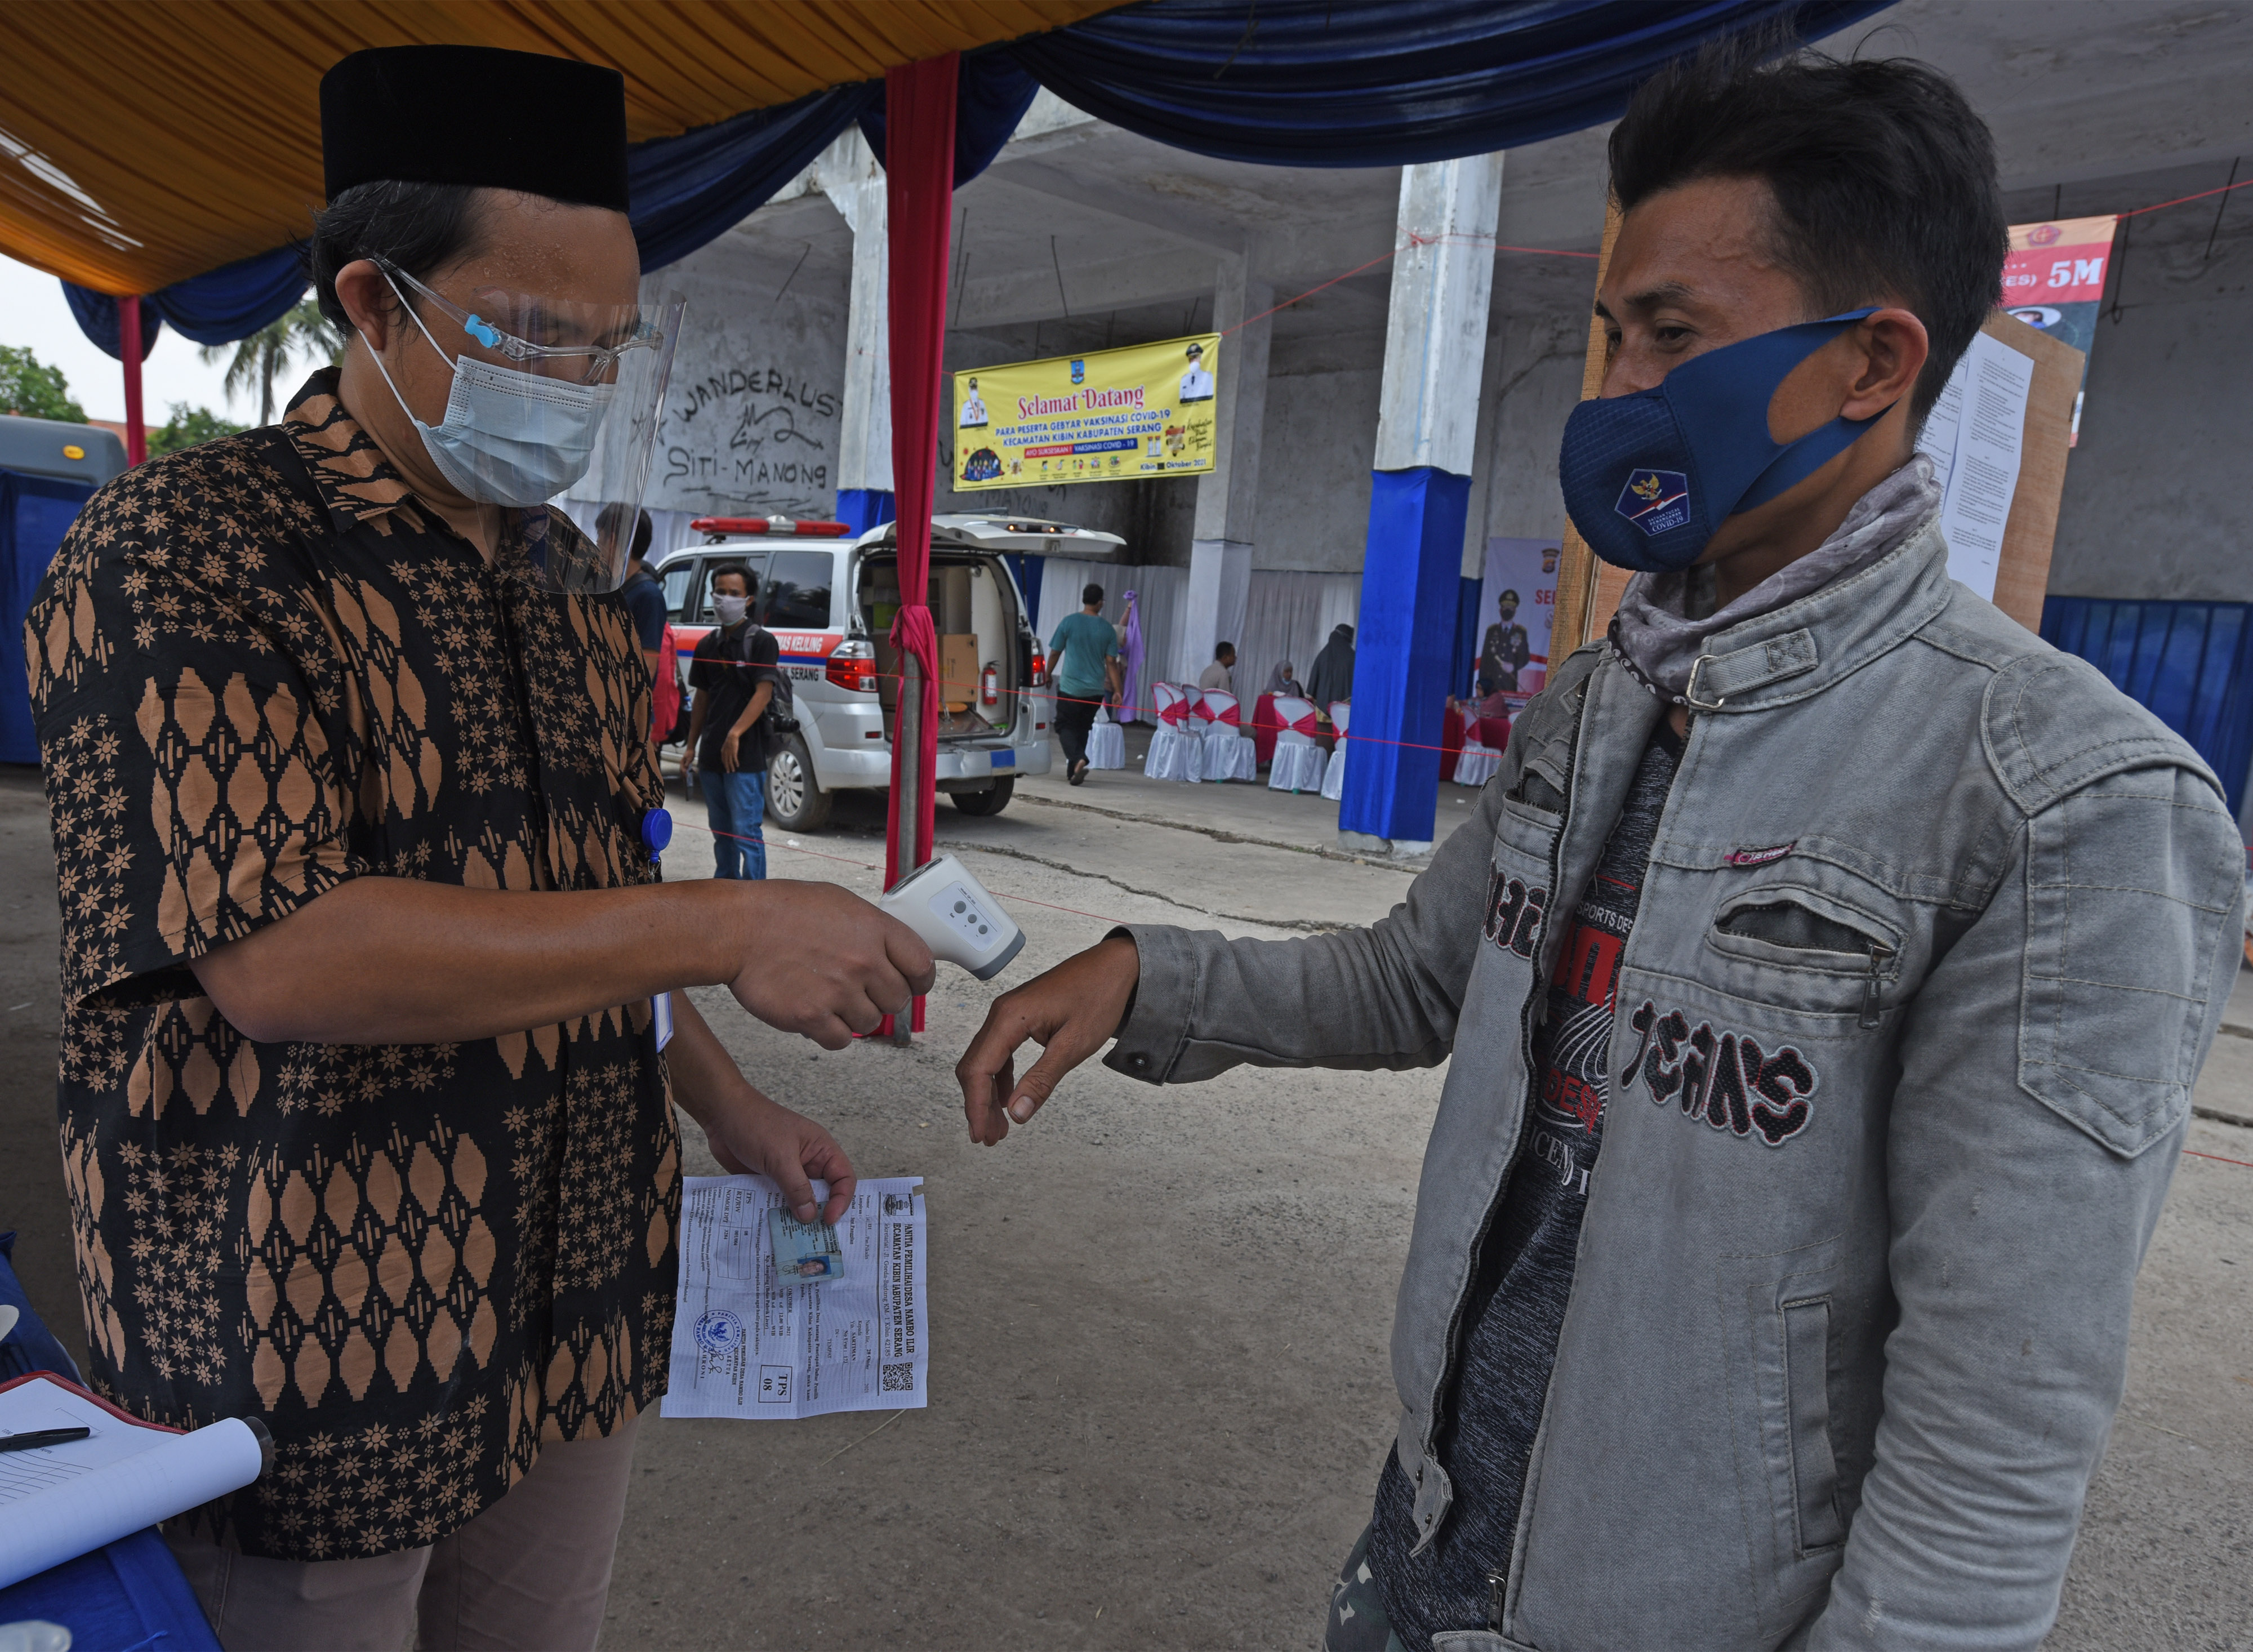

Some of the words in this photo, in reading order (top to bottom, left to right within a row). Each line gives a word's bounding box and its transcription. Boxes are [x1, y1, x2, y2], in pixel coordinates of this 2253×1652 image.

[2047, 257, 2104, 288] 5M
[1018, 394, 1078, 420] Selamat
[1081, 385, 1145, 410] Datang
[996, 427, 1016, 436] PARA
[1018, 423, 1048, 434] PESERTA
[1050, 420, 1081, 431] GEBYAR
[1083, 413, 1128, 426] VAKSINASI
[1130, 409, 1171, 422] COVID-19
[1003, 434, 1050, 447] KECAMATAN
[1052, 431, 1074, 442] KIBIN
[1076, 426, 1124, 439] KABUPATEN
[1126, 422, 1162, 434] SERANG
[1652, 516, 1683, 532] COVID-19
[790, 667, 818, 681] SERANG
[1577, 902, 1617, 927] SPORTS
[905, 1287, 913, 1307] DESA
[718, 1312, 737, 1325] PANITIA
[905, 1309, 914, 1336] NAMBO
[724, 1326, 740, 1352] PEMILIHAN
[894, 1328, 902, 1357] SERANG
[763, 1378, 772, 1391] 08
[777, 1374, 787, 1396] TPS
